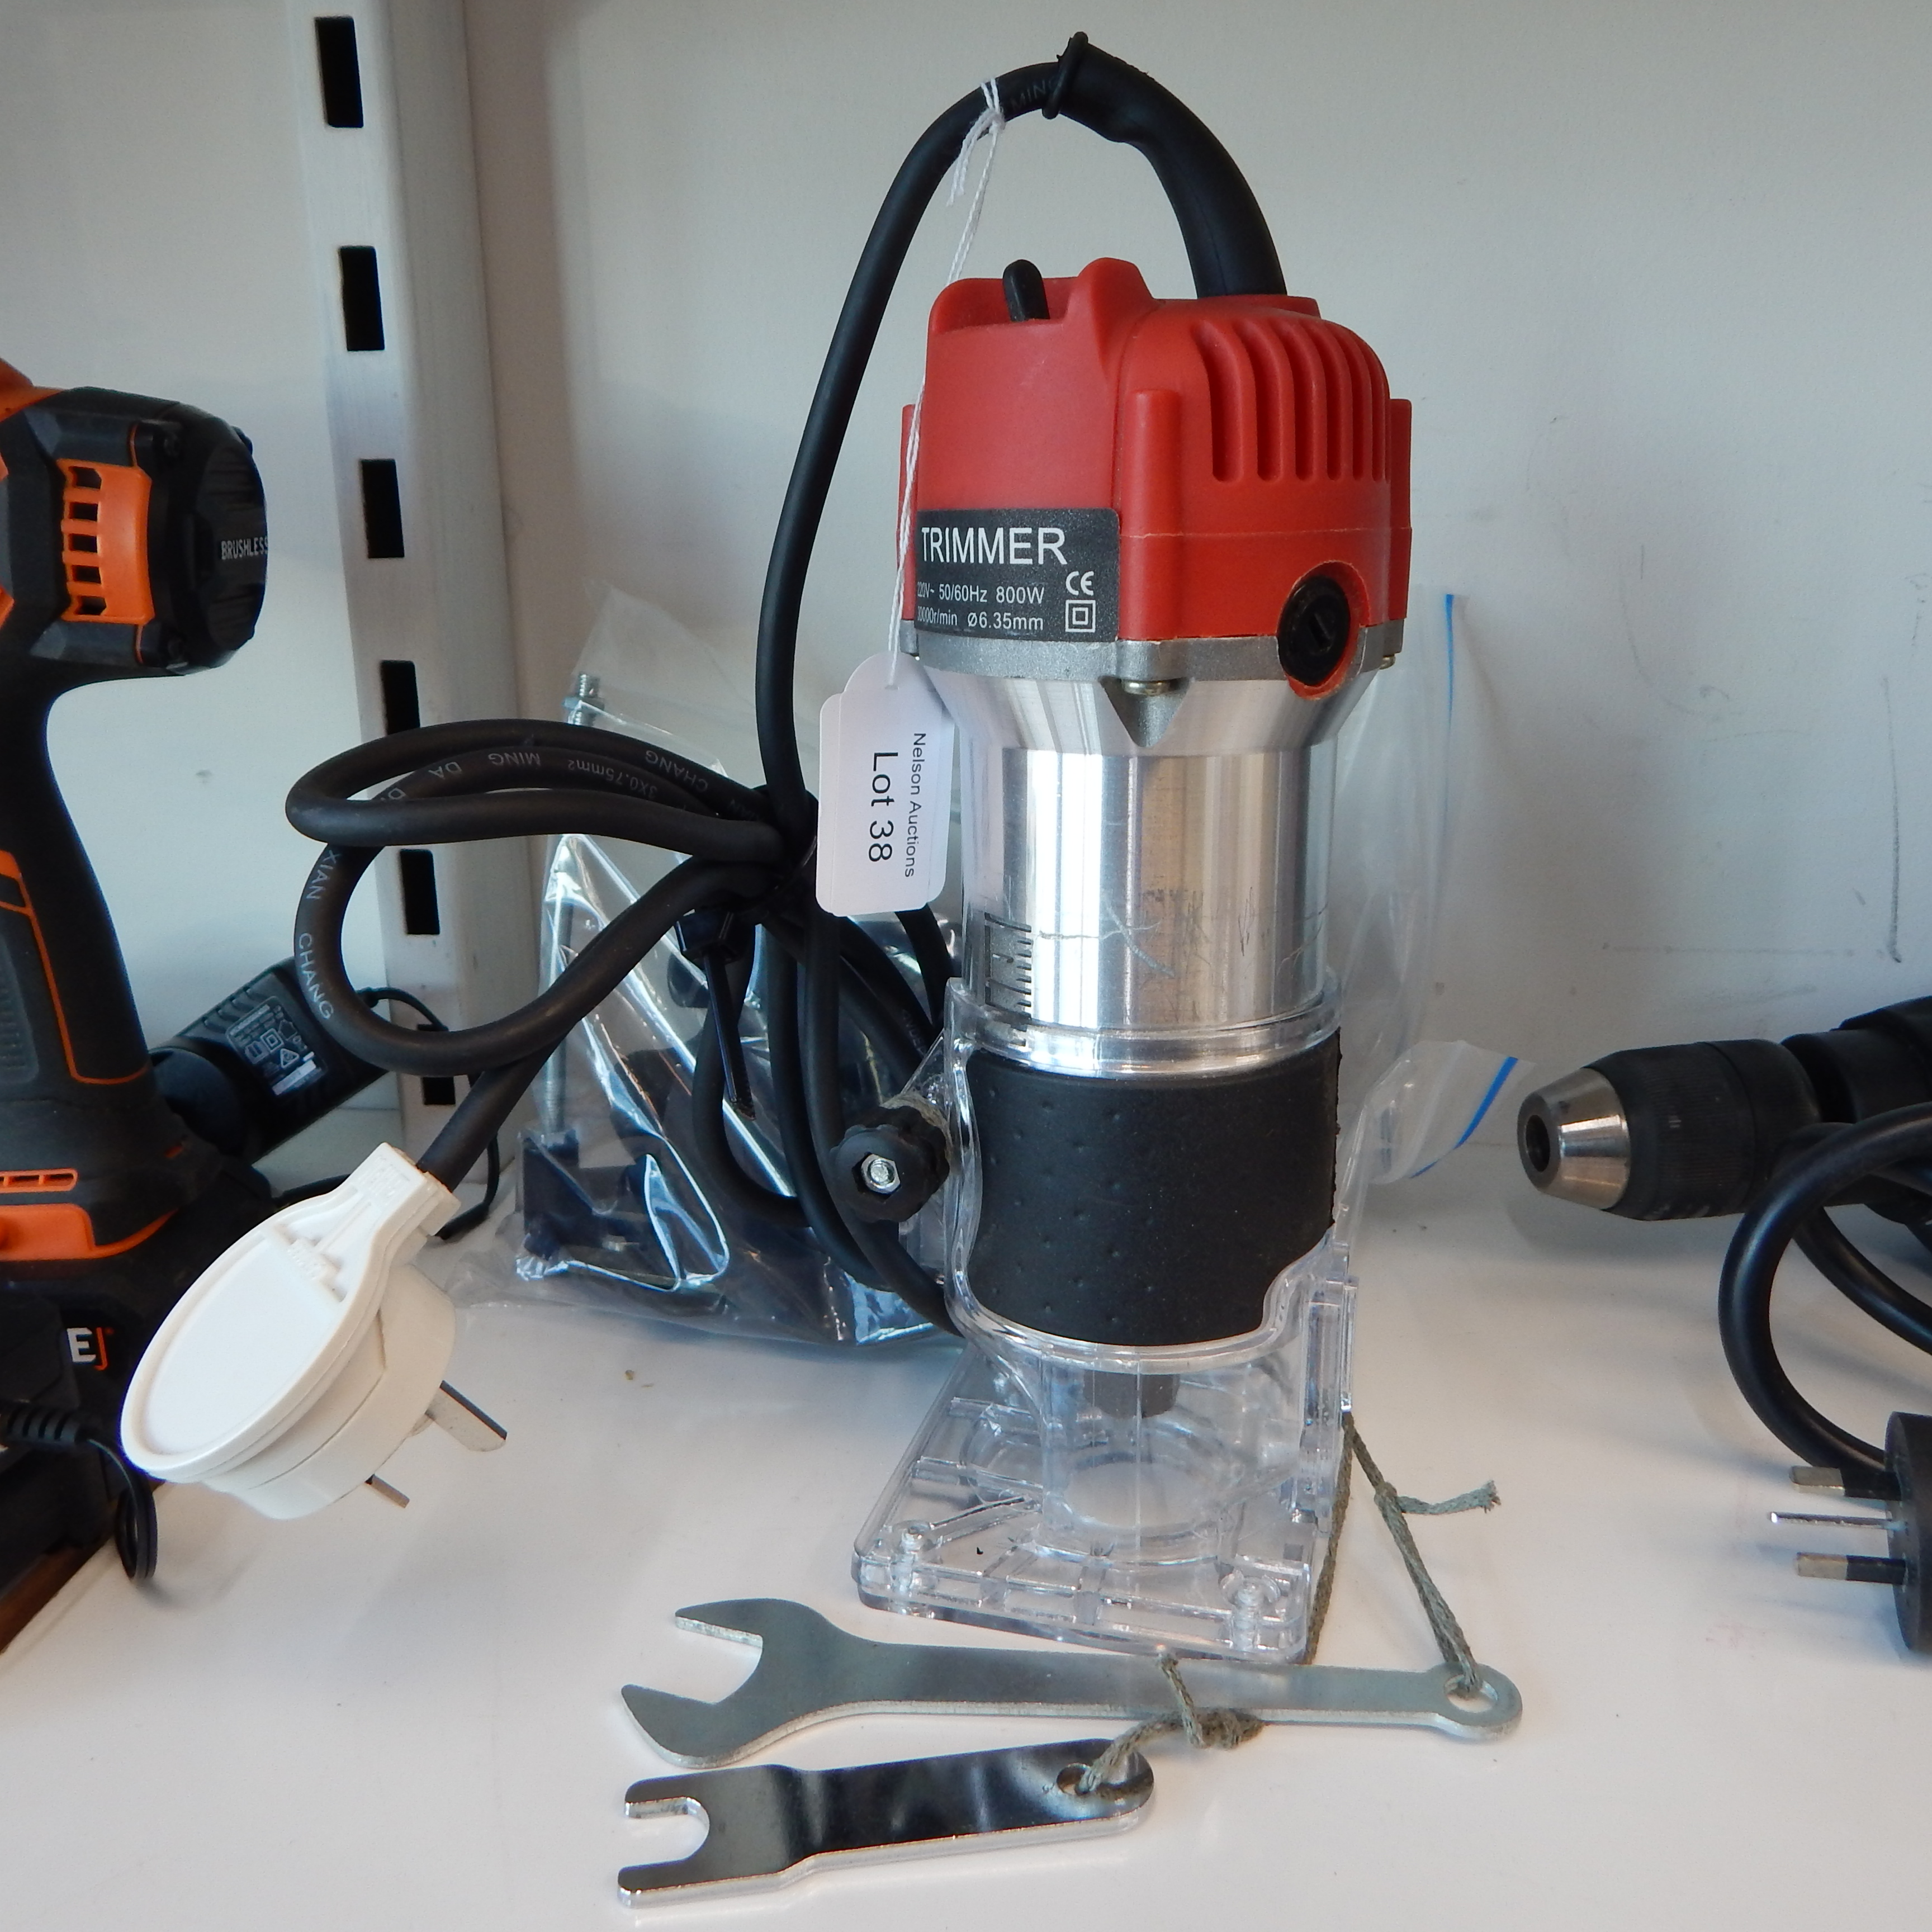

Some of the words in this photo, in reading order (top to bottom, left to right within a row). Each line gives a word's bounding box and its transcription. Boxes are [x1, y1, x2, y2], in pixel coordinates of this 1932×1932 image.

[221, 535, 268, 560] BRUSHLESS
[921, 527, 1068, 565] TRIMMER
[939, 584, 988, 603] 50/60Hz
[995, 585, 1045, 604] 800W
[428, 761, 462, 780] DA
[487, 752, 542, 766] MING
[645, 750, 708, 793] CHANG
[871, 752, 899, 807] Lot
[911, 732, 926, 795] Nelson
[868, 820, 894, 863] 38
[905, 800, 922, 878] Auctions
[305, 850, 342, 899] XIAN
[299, 932, 334, 1020] CHANG
